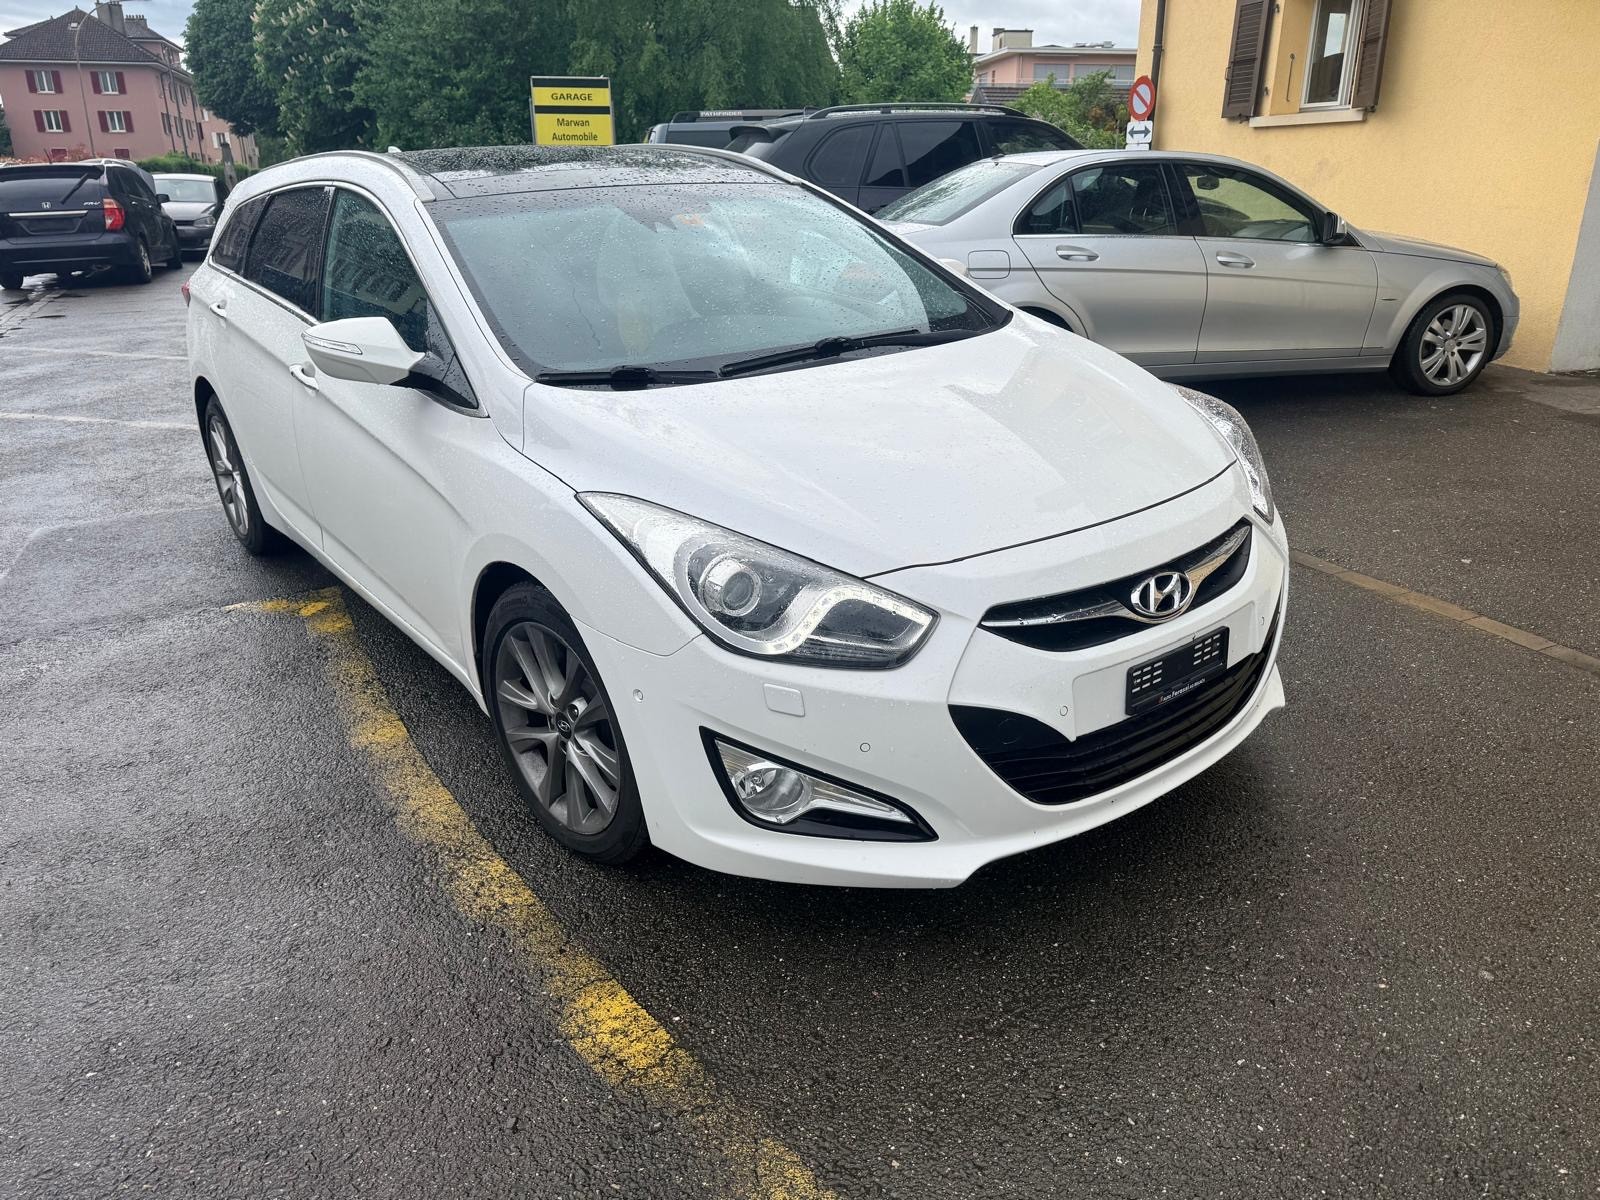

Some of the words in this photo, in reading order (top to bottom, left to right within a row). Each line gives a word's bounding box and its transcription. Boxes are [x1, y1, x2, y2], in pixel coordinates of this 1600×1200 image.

[551, 92, 593, 101] GARAGE
[556, 118, 590, 127] Marwan
[552, 132, 598, 141] Automobile
